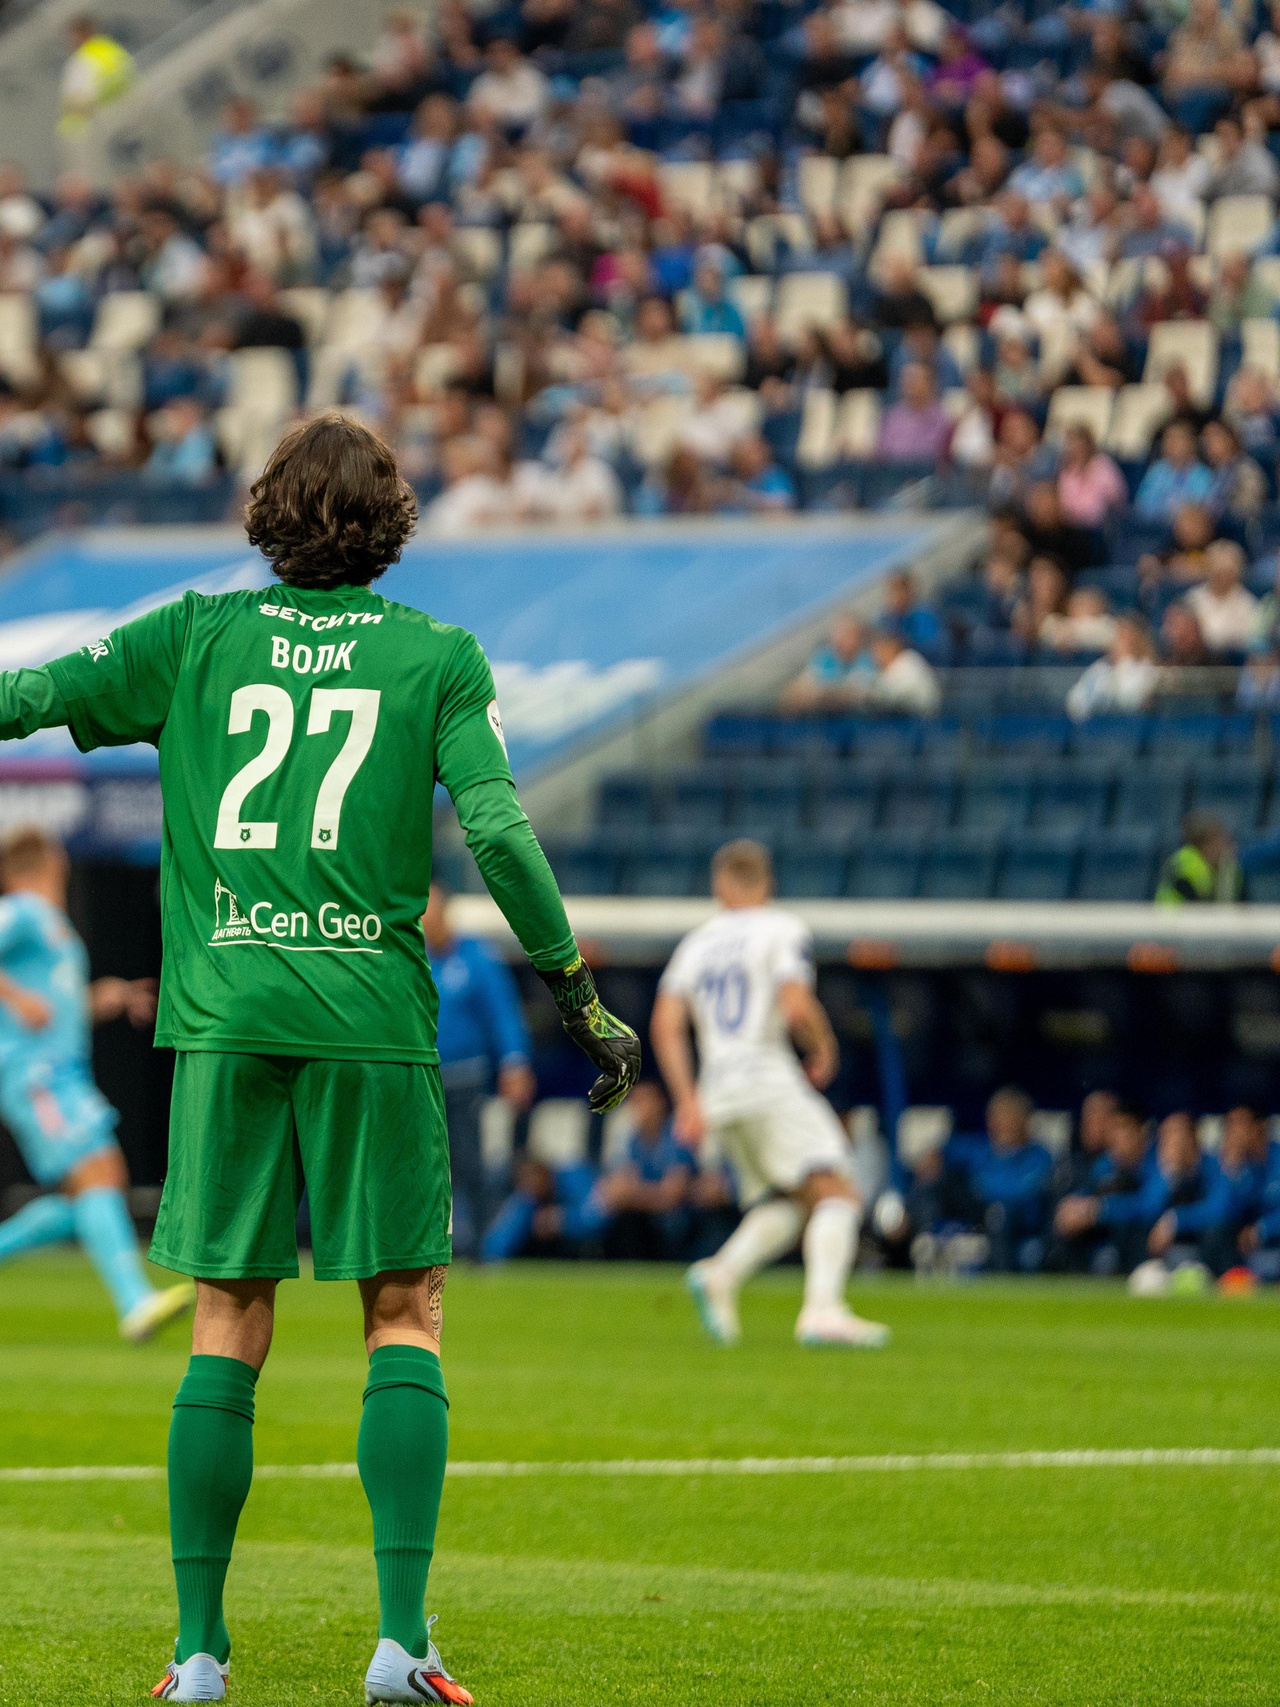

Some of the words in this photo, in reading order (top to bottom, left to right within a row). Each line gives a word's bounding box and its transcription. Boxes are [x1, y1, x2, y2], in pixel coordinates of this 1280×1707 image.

[258, 602, 384, 632] БЕТСИТИ
[270, 635, 358, 675] ВОЛК
[213, 683, 382, 851] 27
[211, 926, 252, 941] ДАГНЕФТЬ
[250, 901, 309, 938] Cen
[318, 901, 382, 941] Geo
